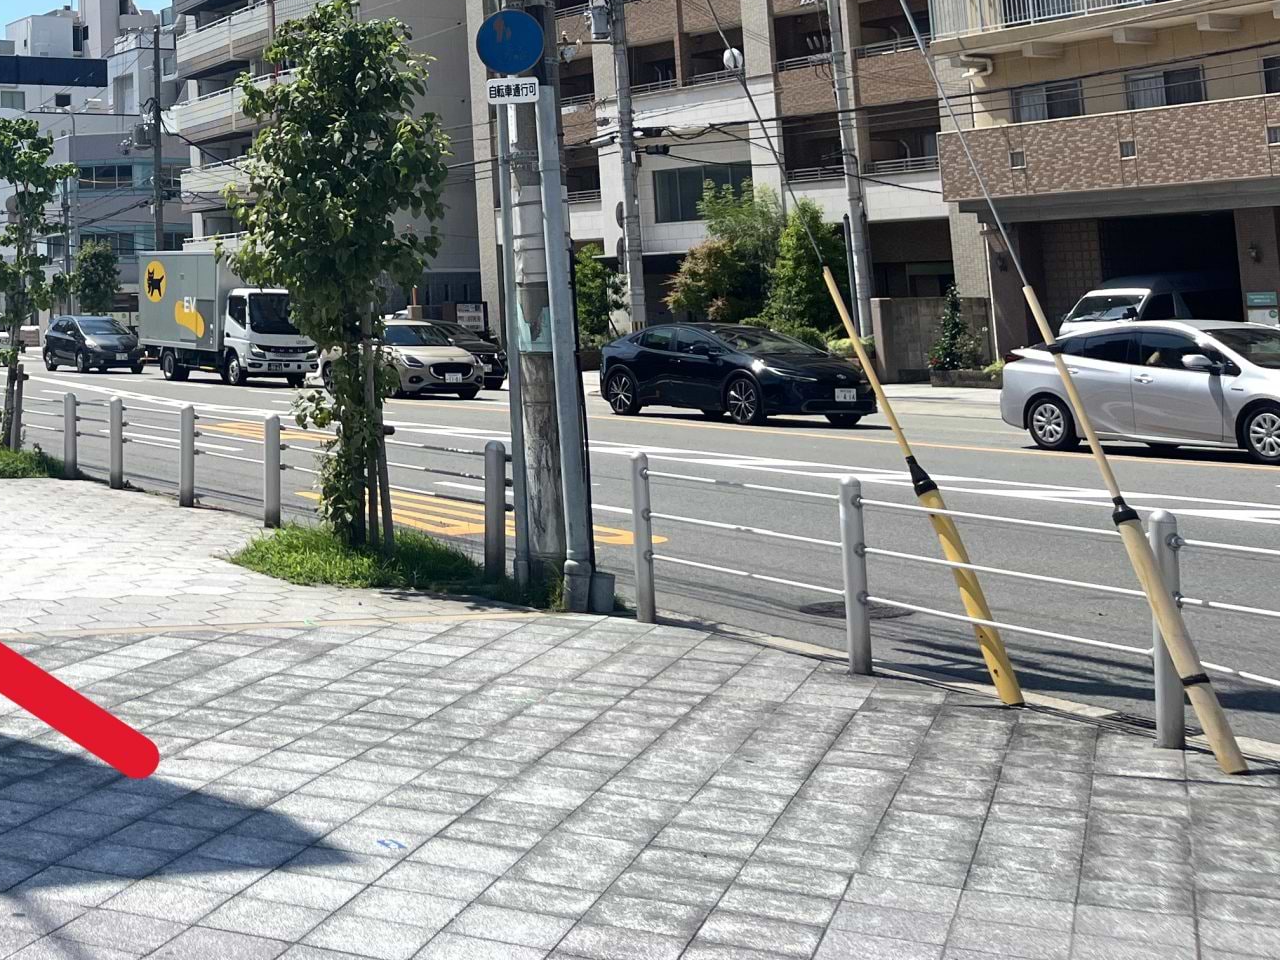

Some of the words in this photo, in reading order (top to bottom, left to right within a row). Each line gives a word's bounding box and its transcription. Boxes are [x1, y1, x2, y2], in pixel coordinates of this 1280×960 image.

[488, 82, 537, 100] 自転車通行可
[183, 296, 197, 313] EV
